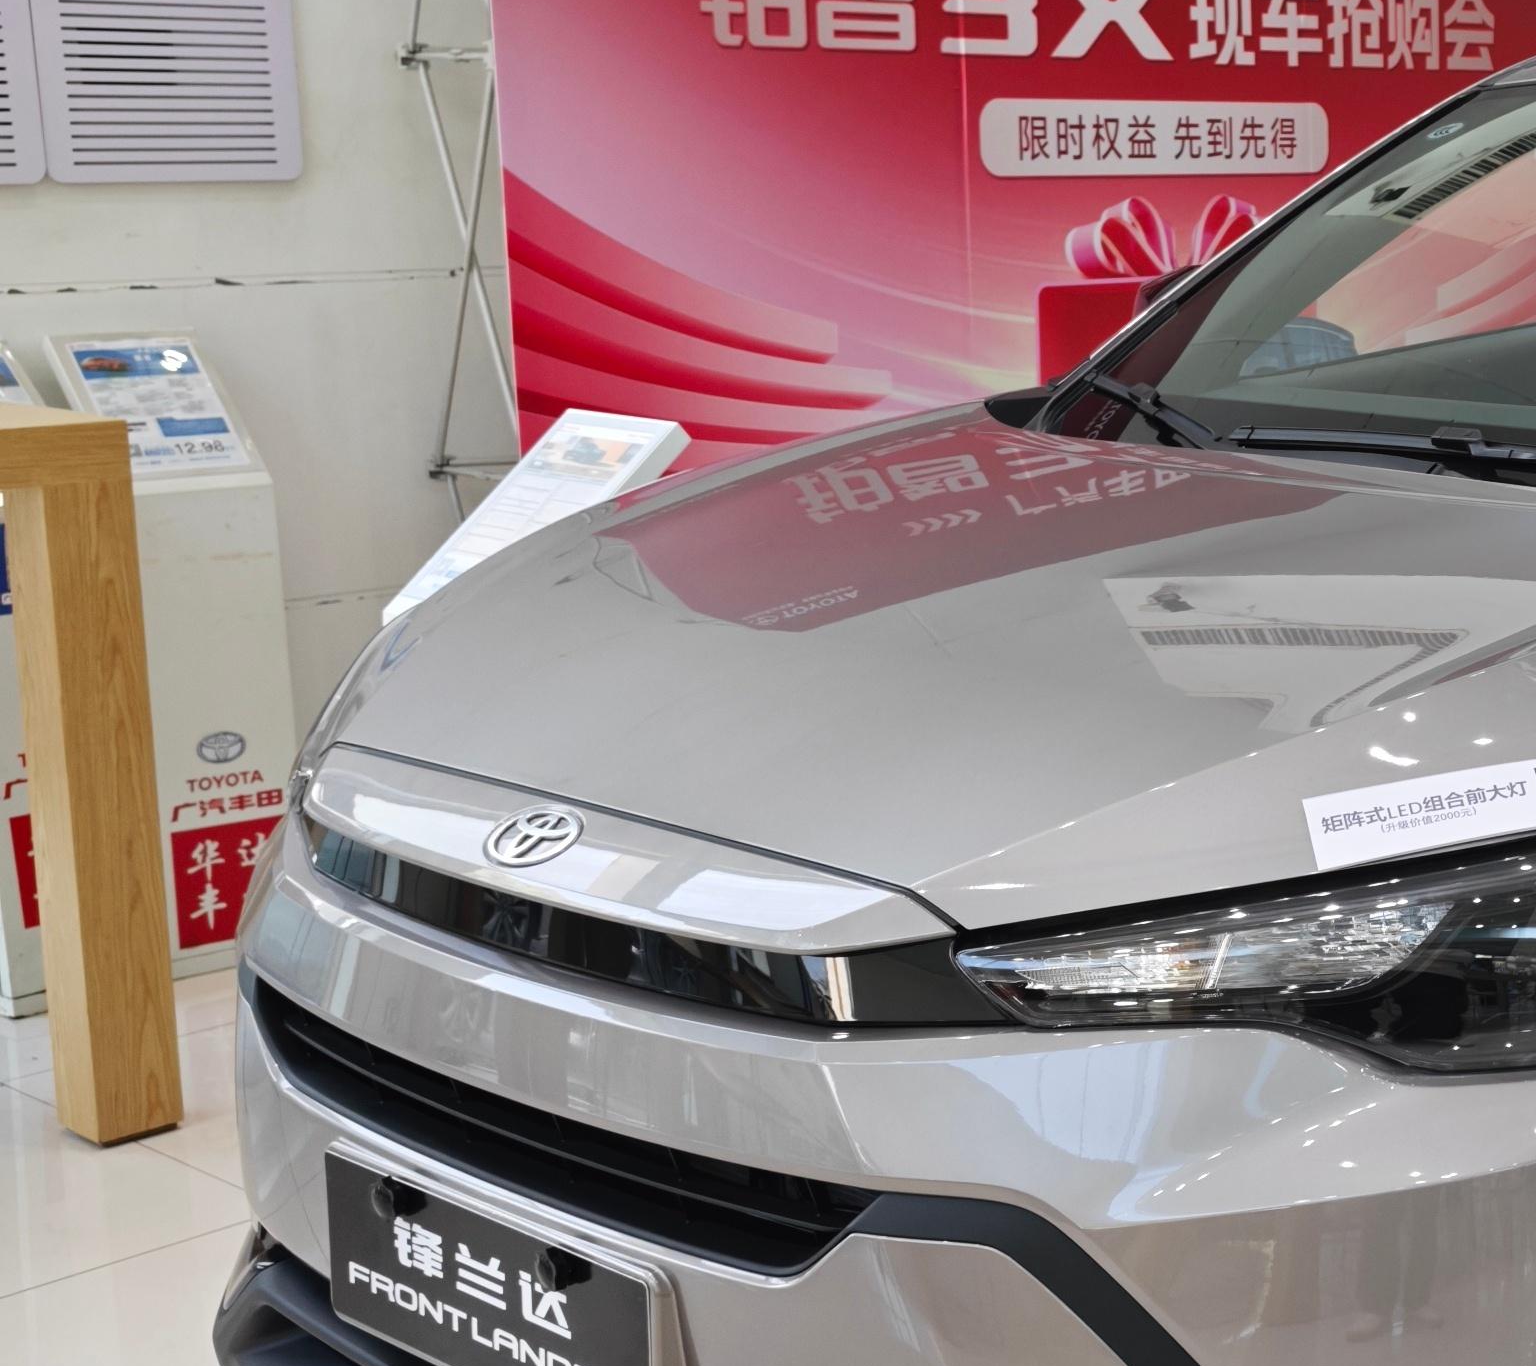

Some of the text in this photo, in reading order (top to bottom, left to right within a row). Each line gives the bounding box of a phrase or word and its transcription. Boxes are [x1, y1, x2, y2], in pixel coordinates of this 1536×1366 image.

[1018, 116, 1298, 161] 限时权益 先到先得
[187, 770, 264, 793] TOYOTA
[171, 788, 283, 823] 广汽丰田
[1321, 780, 1527, 834] 矩阵式LED组合前大灯
[394, 1216, 572, 1340] 锋兰达
